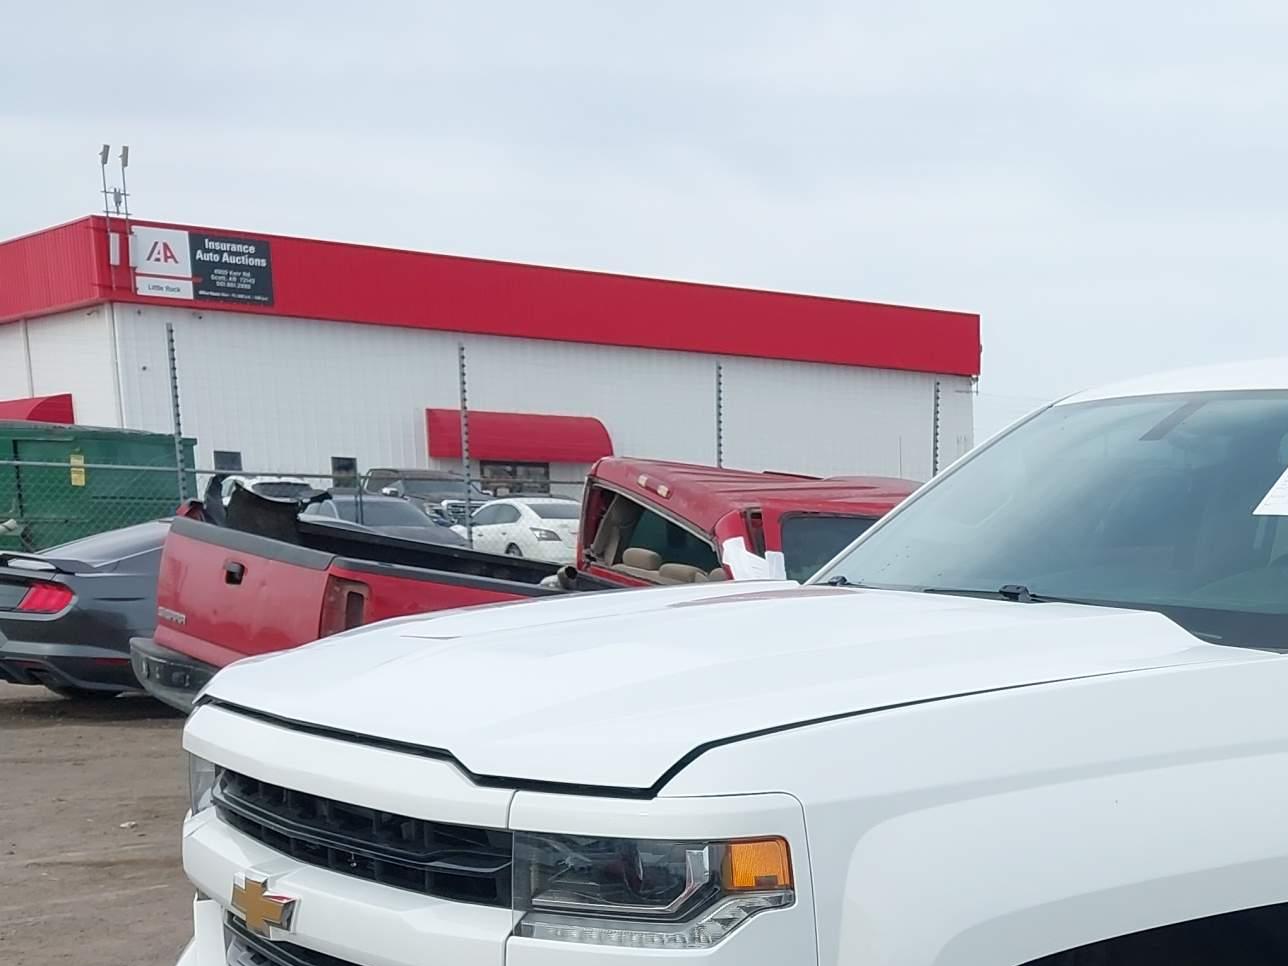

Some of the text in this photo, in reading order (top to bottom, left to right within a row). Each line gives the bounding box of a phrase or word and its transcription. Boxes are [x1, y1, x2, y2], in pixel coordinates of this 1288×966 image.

[205, 239, 255, 253] Insurance
[196, 249, 267, 267] Auto Auctions
